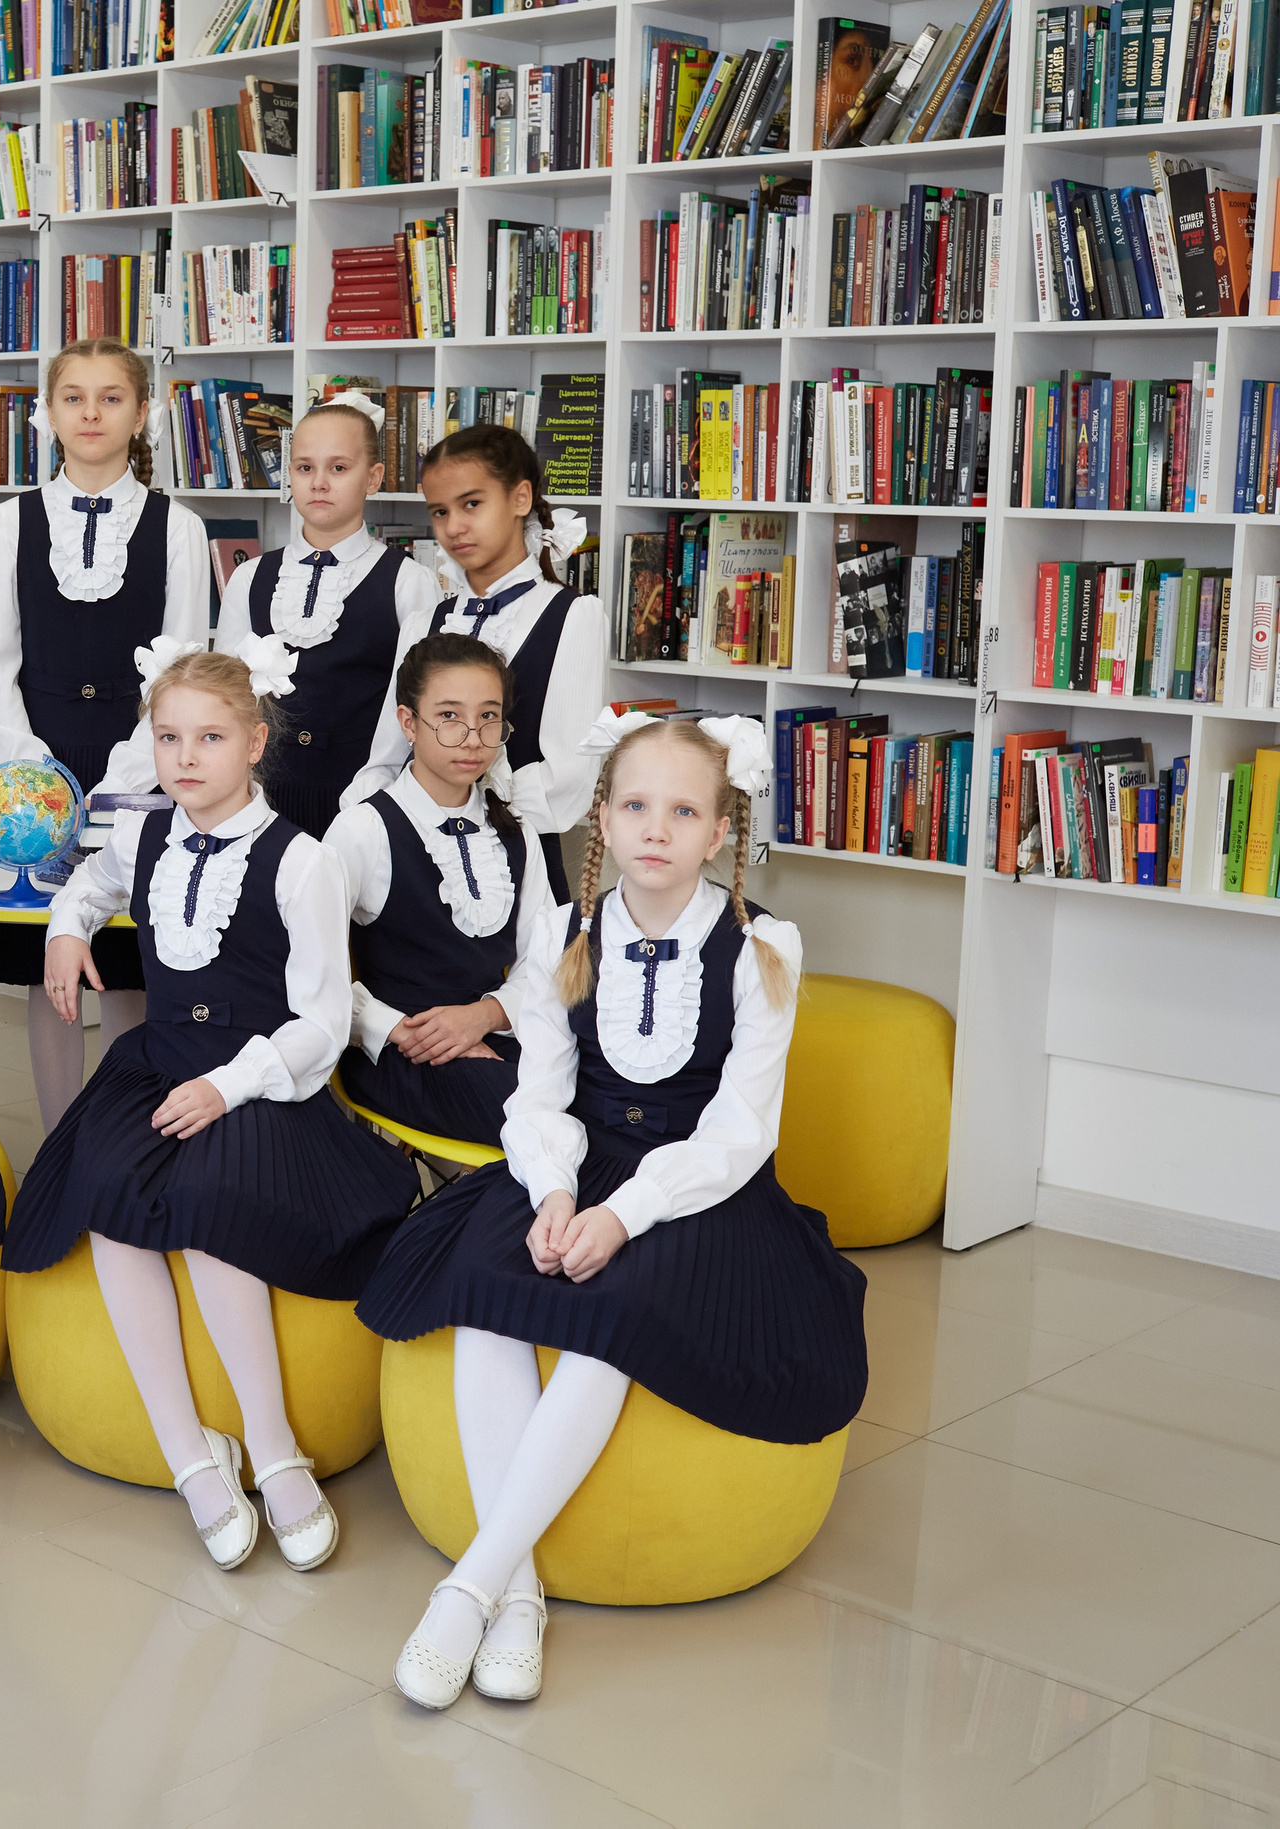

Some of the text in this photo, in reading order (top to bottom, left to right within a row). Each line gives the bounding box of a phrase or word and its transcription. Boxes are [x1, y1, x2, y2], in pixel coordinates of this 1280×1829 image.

[1051, 46, 1065, 93] БЕРДЯЕВ
[1125, 40, 1139, 86] СПИНОЗА
[1150, 37, 1166, 86] КОНФУЦИЙ
[1179, 211, 1204, 224] СТИВЕН
[1180, 219, 1205, 230] ПИНКЕР
[1182, 229, 1205, 240] ЛУЧШЕЕ
[1209, 197, 1221, 241] КОНФУЦИЙ
[898, 221, 908, 288] НУРЕЕВ ПЕТИ
[1132, 236, 1142, 261] ЛОГИКА
[1191, 237, 1202, 245] НАС
[1035, 233, 1047, 301] ВОЛЬТЕР ВРЕМЯ
[161, 296, 172, 308] 76
[945, 408, 958, 469] МАЙЯ ПЛИСЕЦКАЯ
[1113, 390, 1125, 443] ЭСТЕТИКА
[720, 539, 780, 563] Театр эпохи
[961, 545, 971, 637] ДЖОННИ ДЕПП
[1060, 575, 1071, 637] ПСИХОЛОГИЯ
[1080, 579, 1092, 641] ПСИХОЛОГИЯ
[939, 622, 948, 655] ОГНИ
[989, 627, 999, 642] 88
[1220, 587, 1231, 652] ПОЗНАЙ СЕБЯ
[949, 795, 957, 832] ПРАКТИКА
